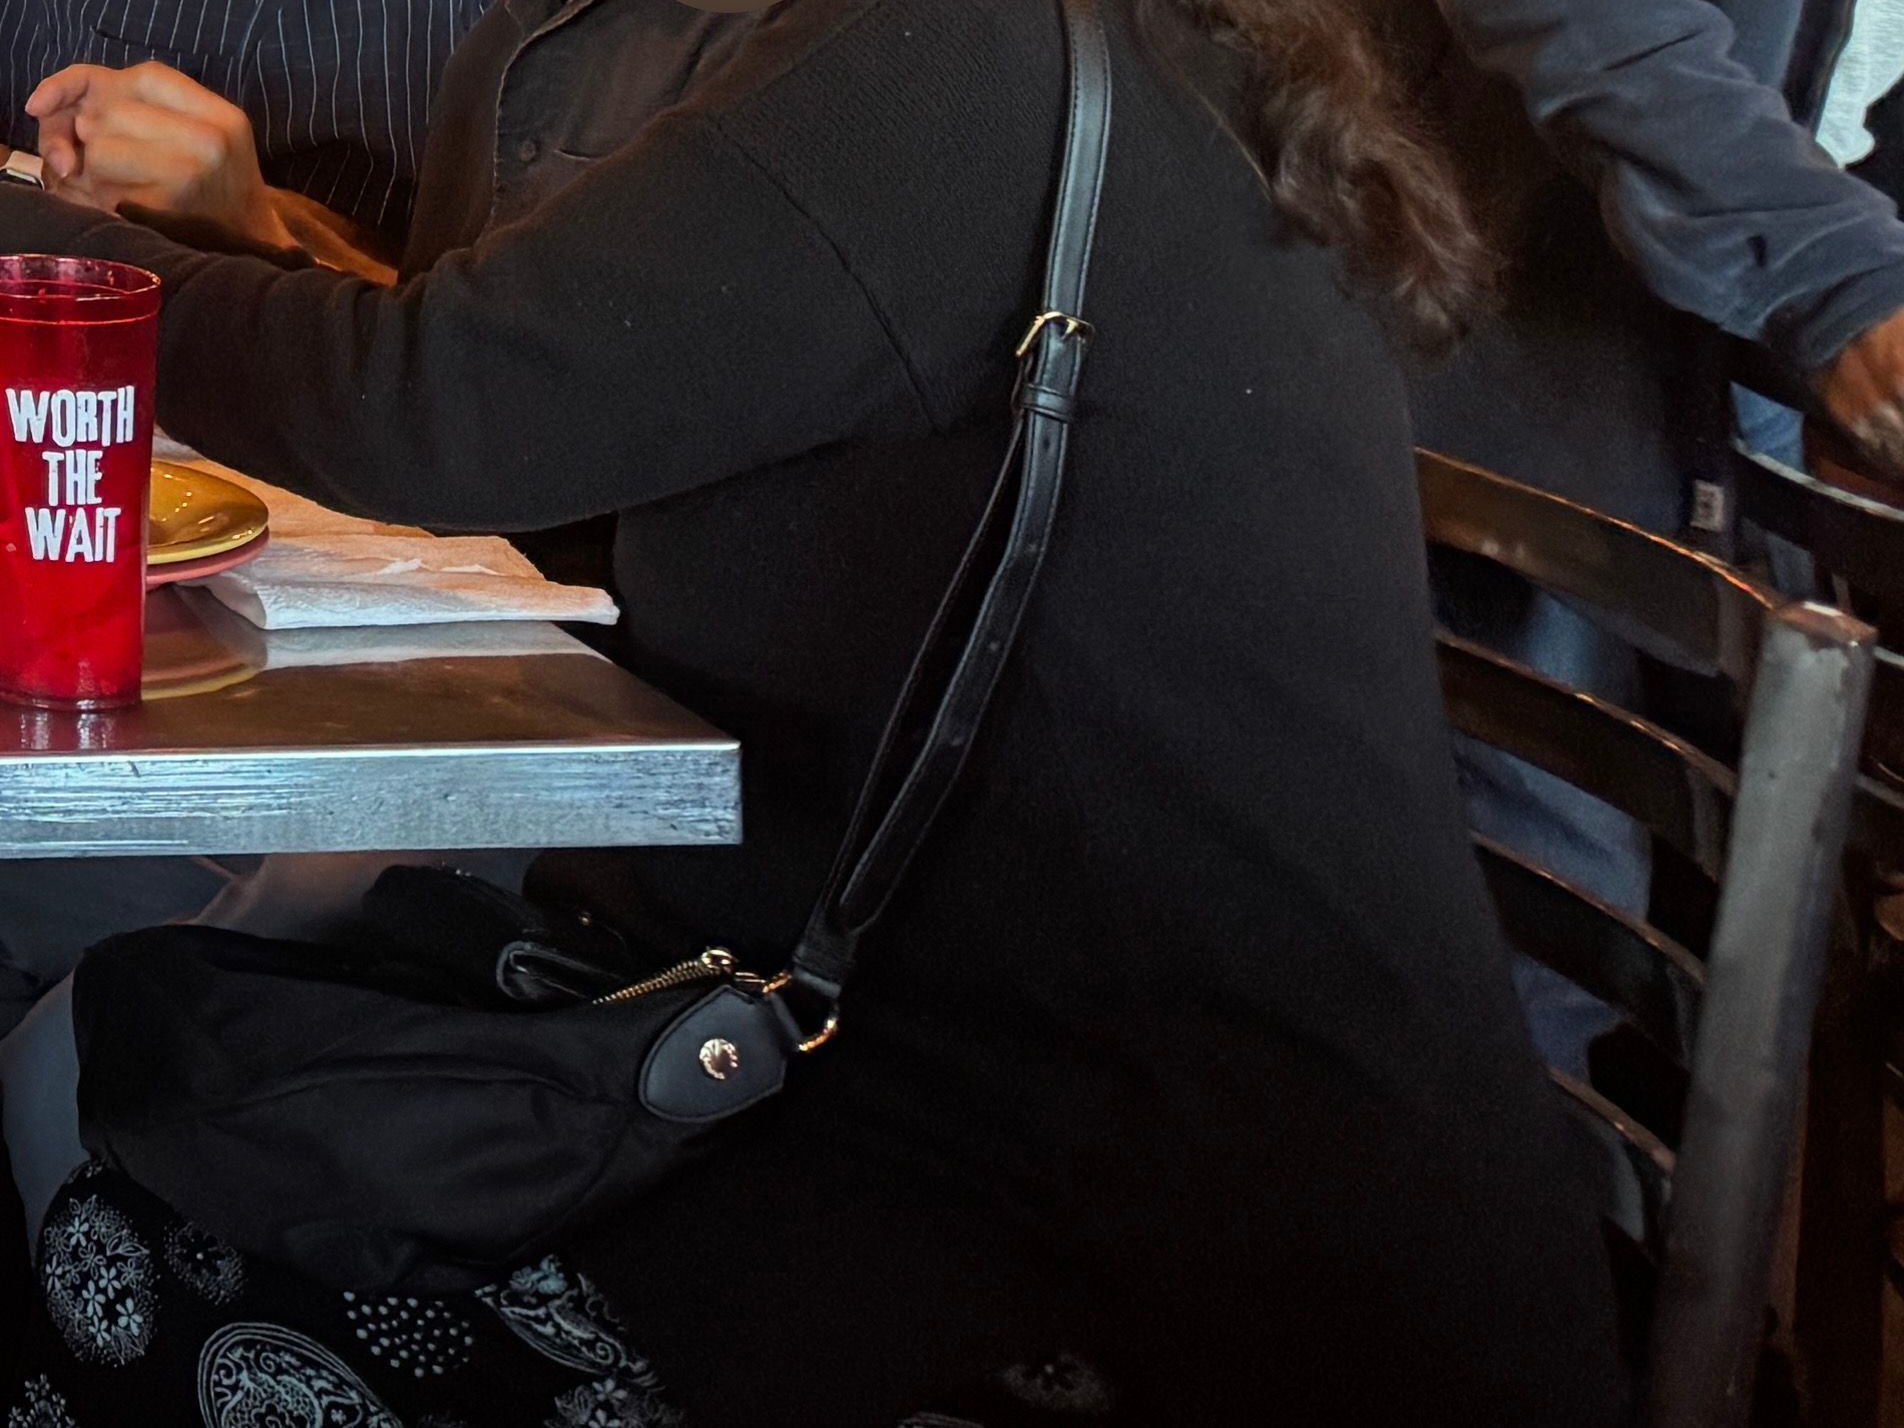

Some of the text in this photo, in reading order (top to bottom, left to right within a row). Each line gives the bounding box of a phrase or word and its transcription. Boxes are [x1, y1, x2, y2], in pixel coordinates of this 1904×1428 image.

[5, 385, 135, 447] WORTH
[42, 449, 103, 506] THE
[25, 507, 121, 563] WAIT
